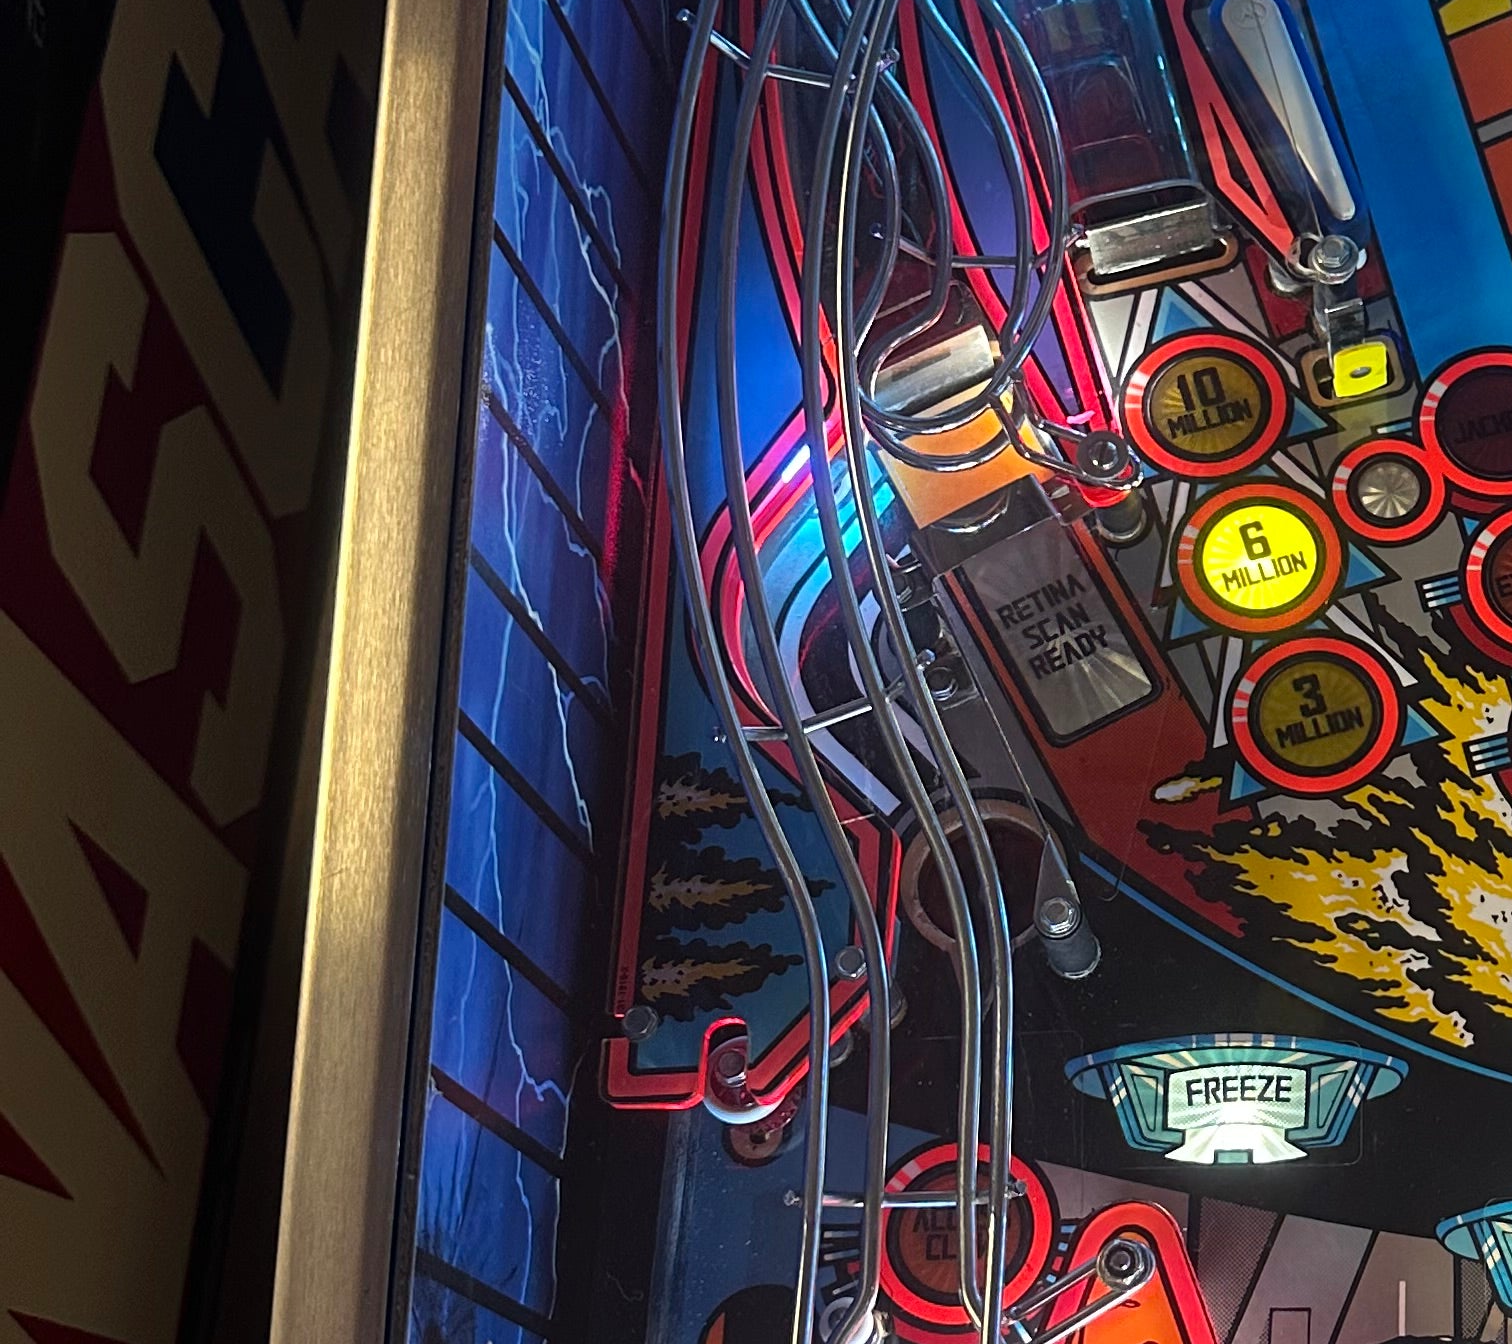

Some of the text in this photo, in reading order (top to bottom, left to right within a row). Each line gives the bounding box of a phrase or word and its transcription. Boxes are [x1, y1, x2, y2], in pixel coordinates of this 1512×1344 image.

[1177, 367, 1227, 413] 10
[1167, 399, 1252, 438] MILLION
[1239, 521, 1271, 561] 6
[1222, 551, 1308, 592] MILLION
[996, 574, 1087, 629] RETINA
[1022, 602, 1091, 650] SCAN
[1028, 624, 1108, 680] READY
[1293, 674, 1327, 717] 3
[1276, 707, 1364, 748] MILLION
[1184, 1075, 1293, 1108] FREEZE
